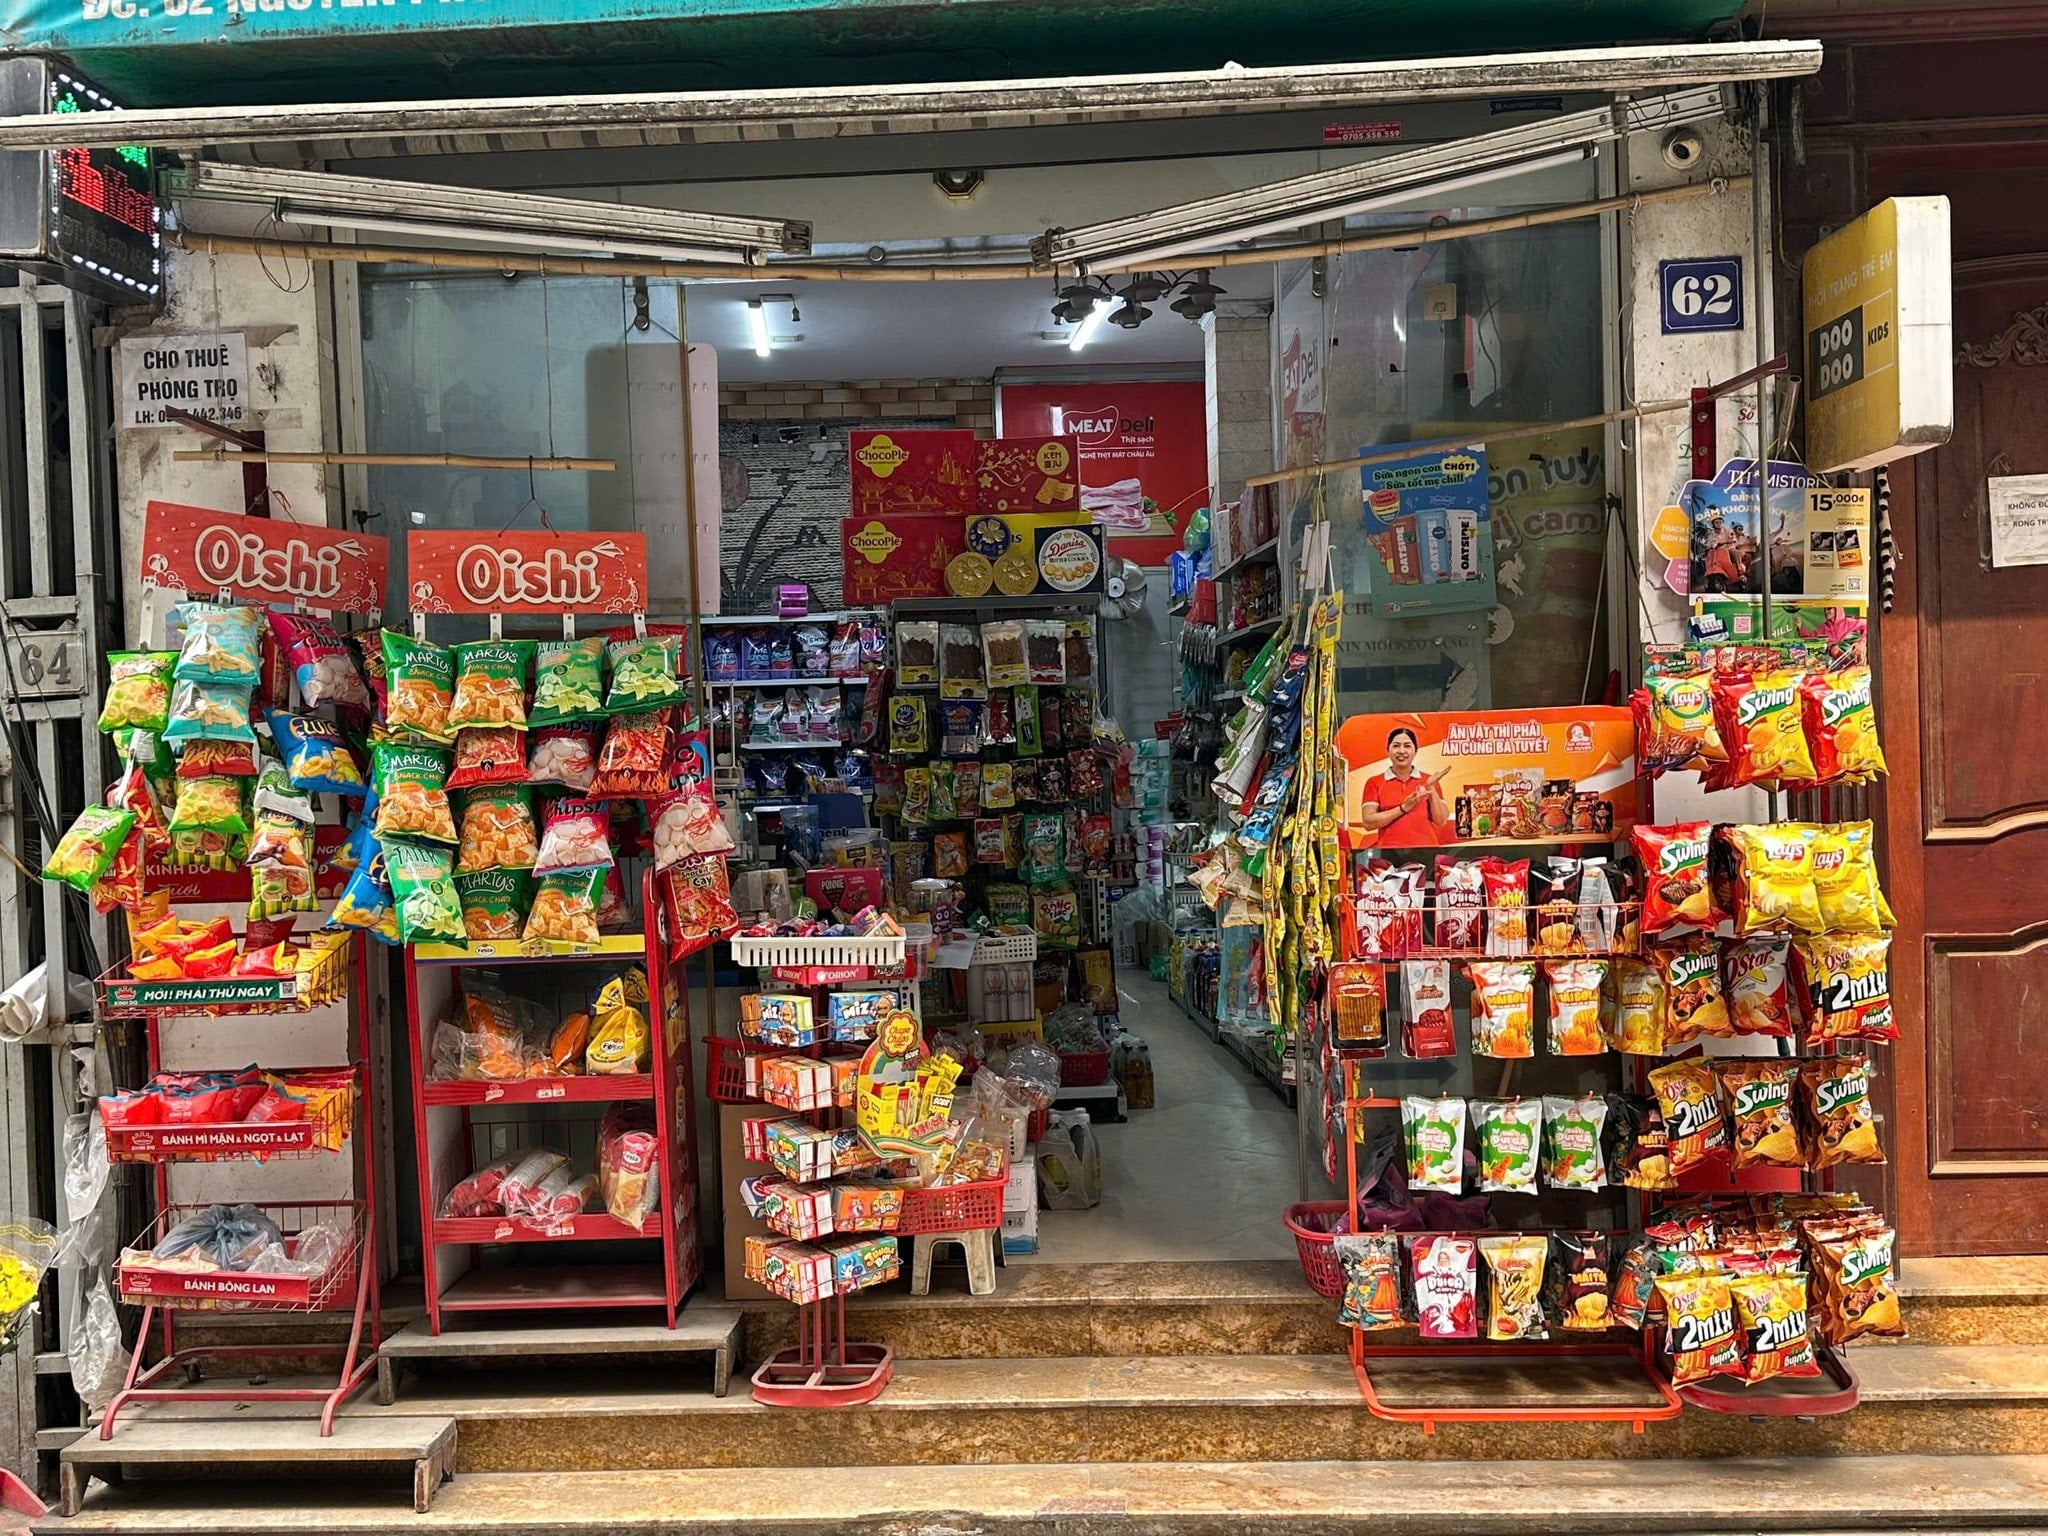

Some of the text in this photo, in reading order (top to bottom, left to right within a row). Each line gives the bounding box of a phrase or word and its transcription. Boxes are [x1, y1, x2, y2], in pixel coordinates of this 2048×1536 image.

[1879, 248, 1893, 272] EM
[1671, 273, 1733, 316] 62
[1820, 319, 1853, 357] DOO
[1867, 321, 1889, 346] KIDS
[144, 344, 229, 369] CHO THUÊ
[1820, 352, 1853, 390] DOO
[138, 377, 238, 401] PHÒNG TRỌ
[135, 410, 155, 423] LH:
[1068, 416, 1154, 433] MEAT Deli
[1120, 436, 1136, 444] Thịt
[856, 449, 908, 461] ChocoPie
[1374, 469, 1394, 481] Sữa
[1395, 467, 1421, 478] ngon
[1422, 464, 1441, 473] con
[1386, 475, 1464, 491] Sữa tốt mẹ chill
[2008, 501, 2037, 511] KHÔNG
[1523, 512, 1599, 535] cam
[850, 536, 901, 547] ChocoPie
[1047, 538, 1086, 557] Danisa
[1396, 526, 1409, 574] OATSIDE
[1427, 520, 1440, 571] OATSIDE
[1461, 521, 1470, 570] OATSIDE
[195, 525, 341, 598] Oishi
[457, 543, 602, 605] Oishi
[1770, 624, 1793, 639] HILL
[19, 641, 72, 686] 64
[464, 648, 518, 666] MARTY'S
[491, 664, 513, 674] CHAY
[1738, 686, 1795, 724] Swing
[1821, 685, 1871, 726] Swing
[1450, 724, 1466, 740] ĂN
[1514, 719, 1541, 737] PHẢI
[1442, 736, 1549, 756] ĂN CÙNG BÀ TUYẾT
[390, 754, 446, 775] MARTY'S
[146, 864, 185, 876] KINH
[1659, 842, 1709, 876] Swing
[461, 872, 515, 894] MARTY'S
[692, 876, 712, 887] Cay
[827, 969, 857, 980] ORION
[1669, 953, 1718, 986] Swing
[237, 986, 274, 998] NGAY
[1829, 971, 1887, 1010] 2mix
[1735, 1082, 1789, 1116] Swing
[1816, 1075, 1868, 1115] Swing
[162, 1133, 196, 1145] BÁNH
[196, 1132, 208, 1145] MÌ
[209, 1132, 235, 1146] MẶN
[244, 1132, 276, 1145] NGỌT
[284, 1132, 305, 1145] LẠT
[1840, 1249, 1892, 1286] Swing
[184, 1278, 276, 1294] BÁNH BÔNG LAN
[1678, 1308, 1733, 1350] 2mix
[1755, 1309, 1806, 1351] 2mix
